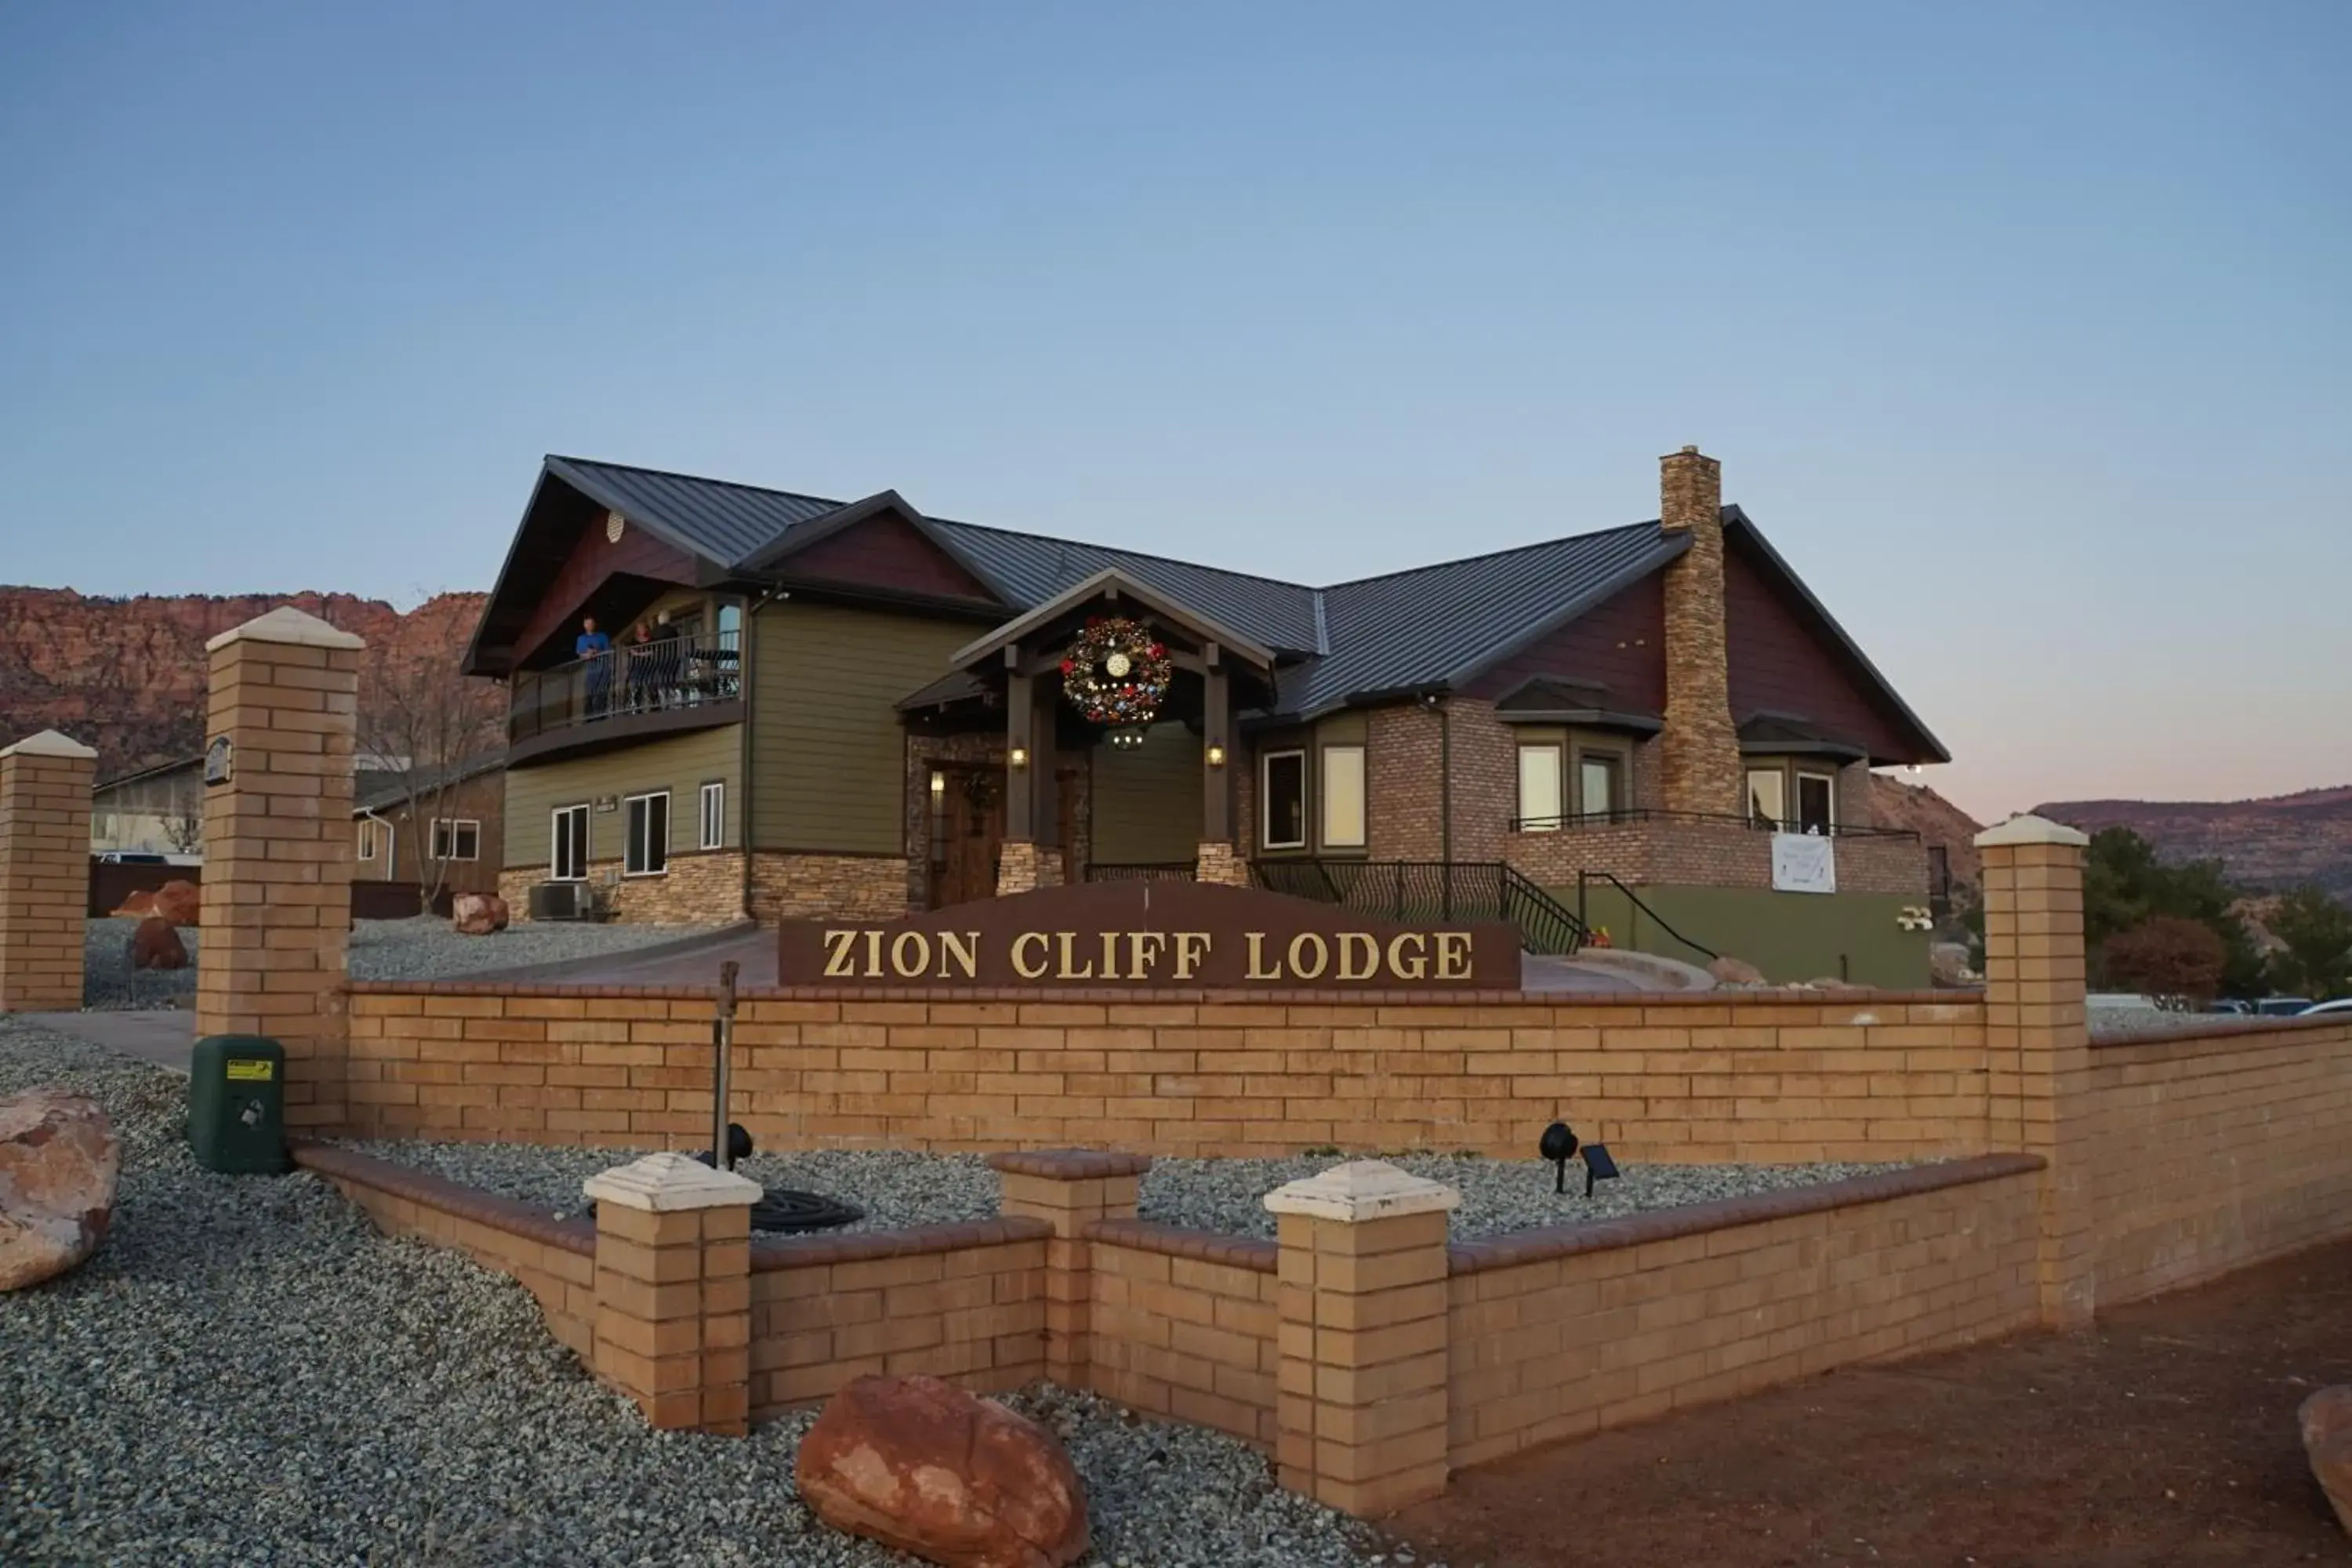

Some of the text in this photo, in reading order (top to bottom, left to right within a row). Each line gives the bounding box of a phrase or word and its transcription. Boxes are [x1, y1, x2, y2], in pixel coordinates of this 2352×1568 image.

[823, 930, 1472, 980] ZION CLIFF LODGE
